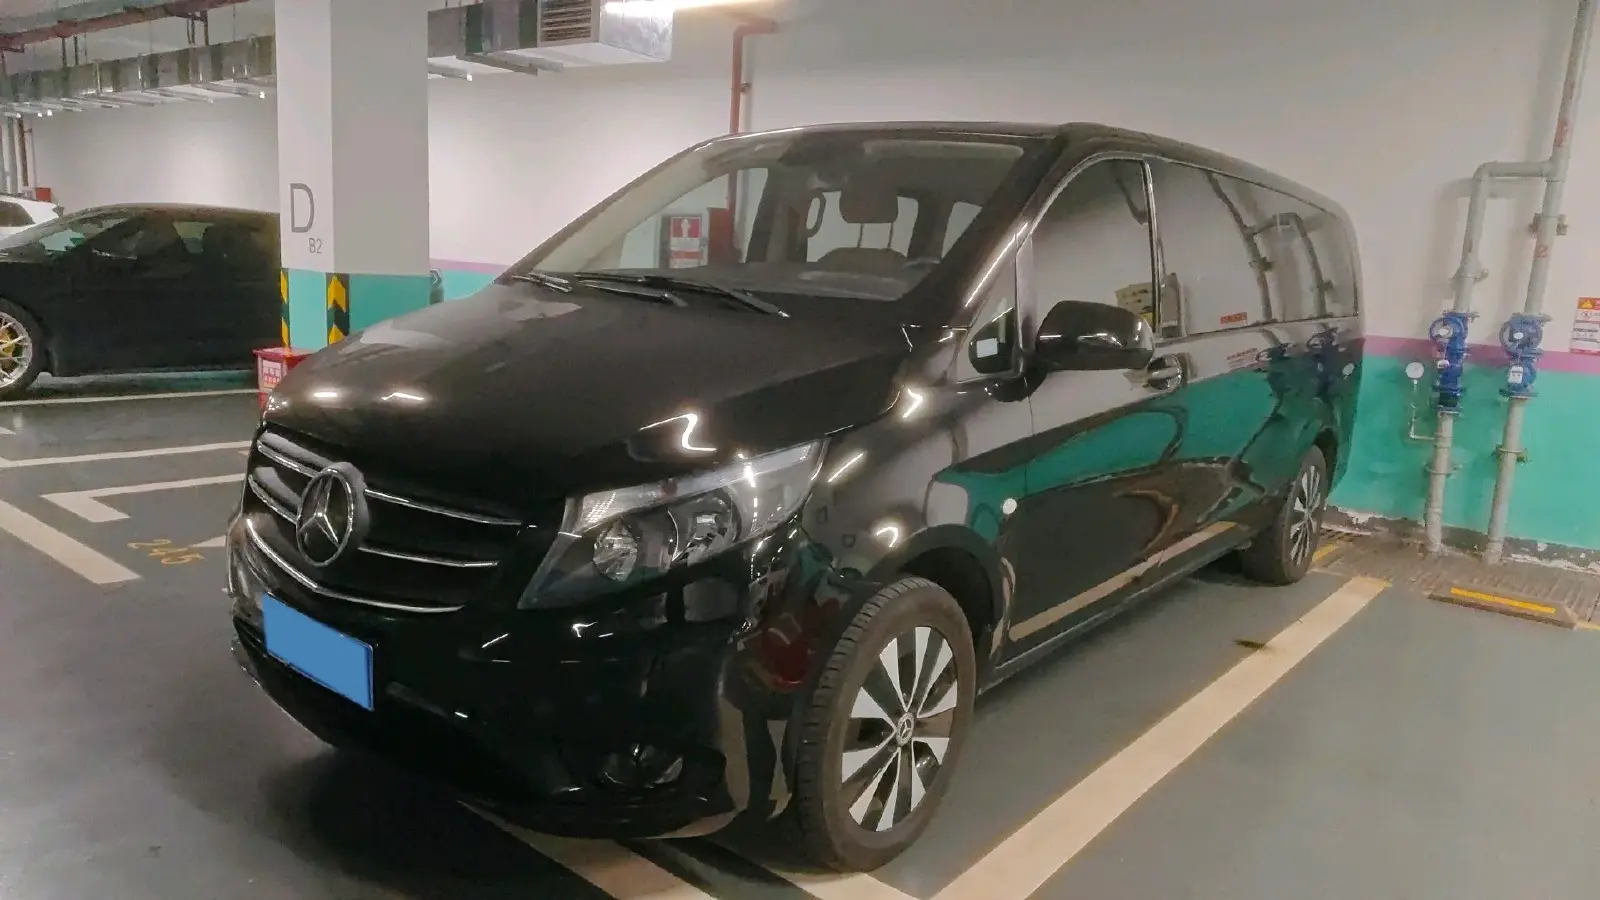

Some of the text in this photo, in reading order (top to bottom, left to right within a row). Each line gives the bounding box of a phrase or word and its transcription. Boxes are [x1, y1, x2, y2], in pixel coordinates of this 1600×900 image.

[290, 183, 314, 233] D
[309, 237, 323, 254] B2
[127, 538, 206, 566] 245
